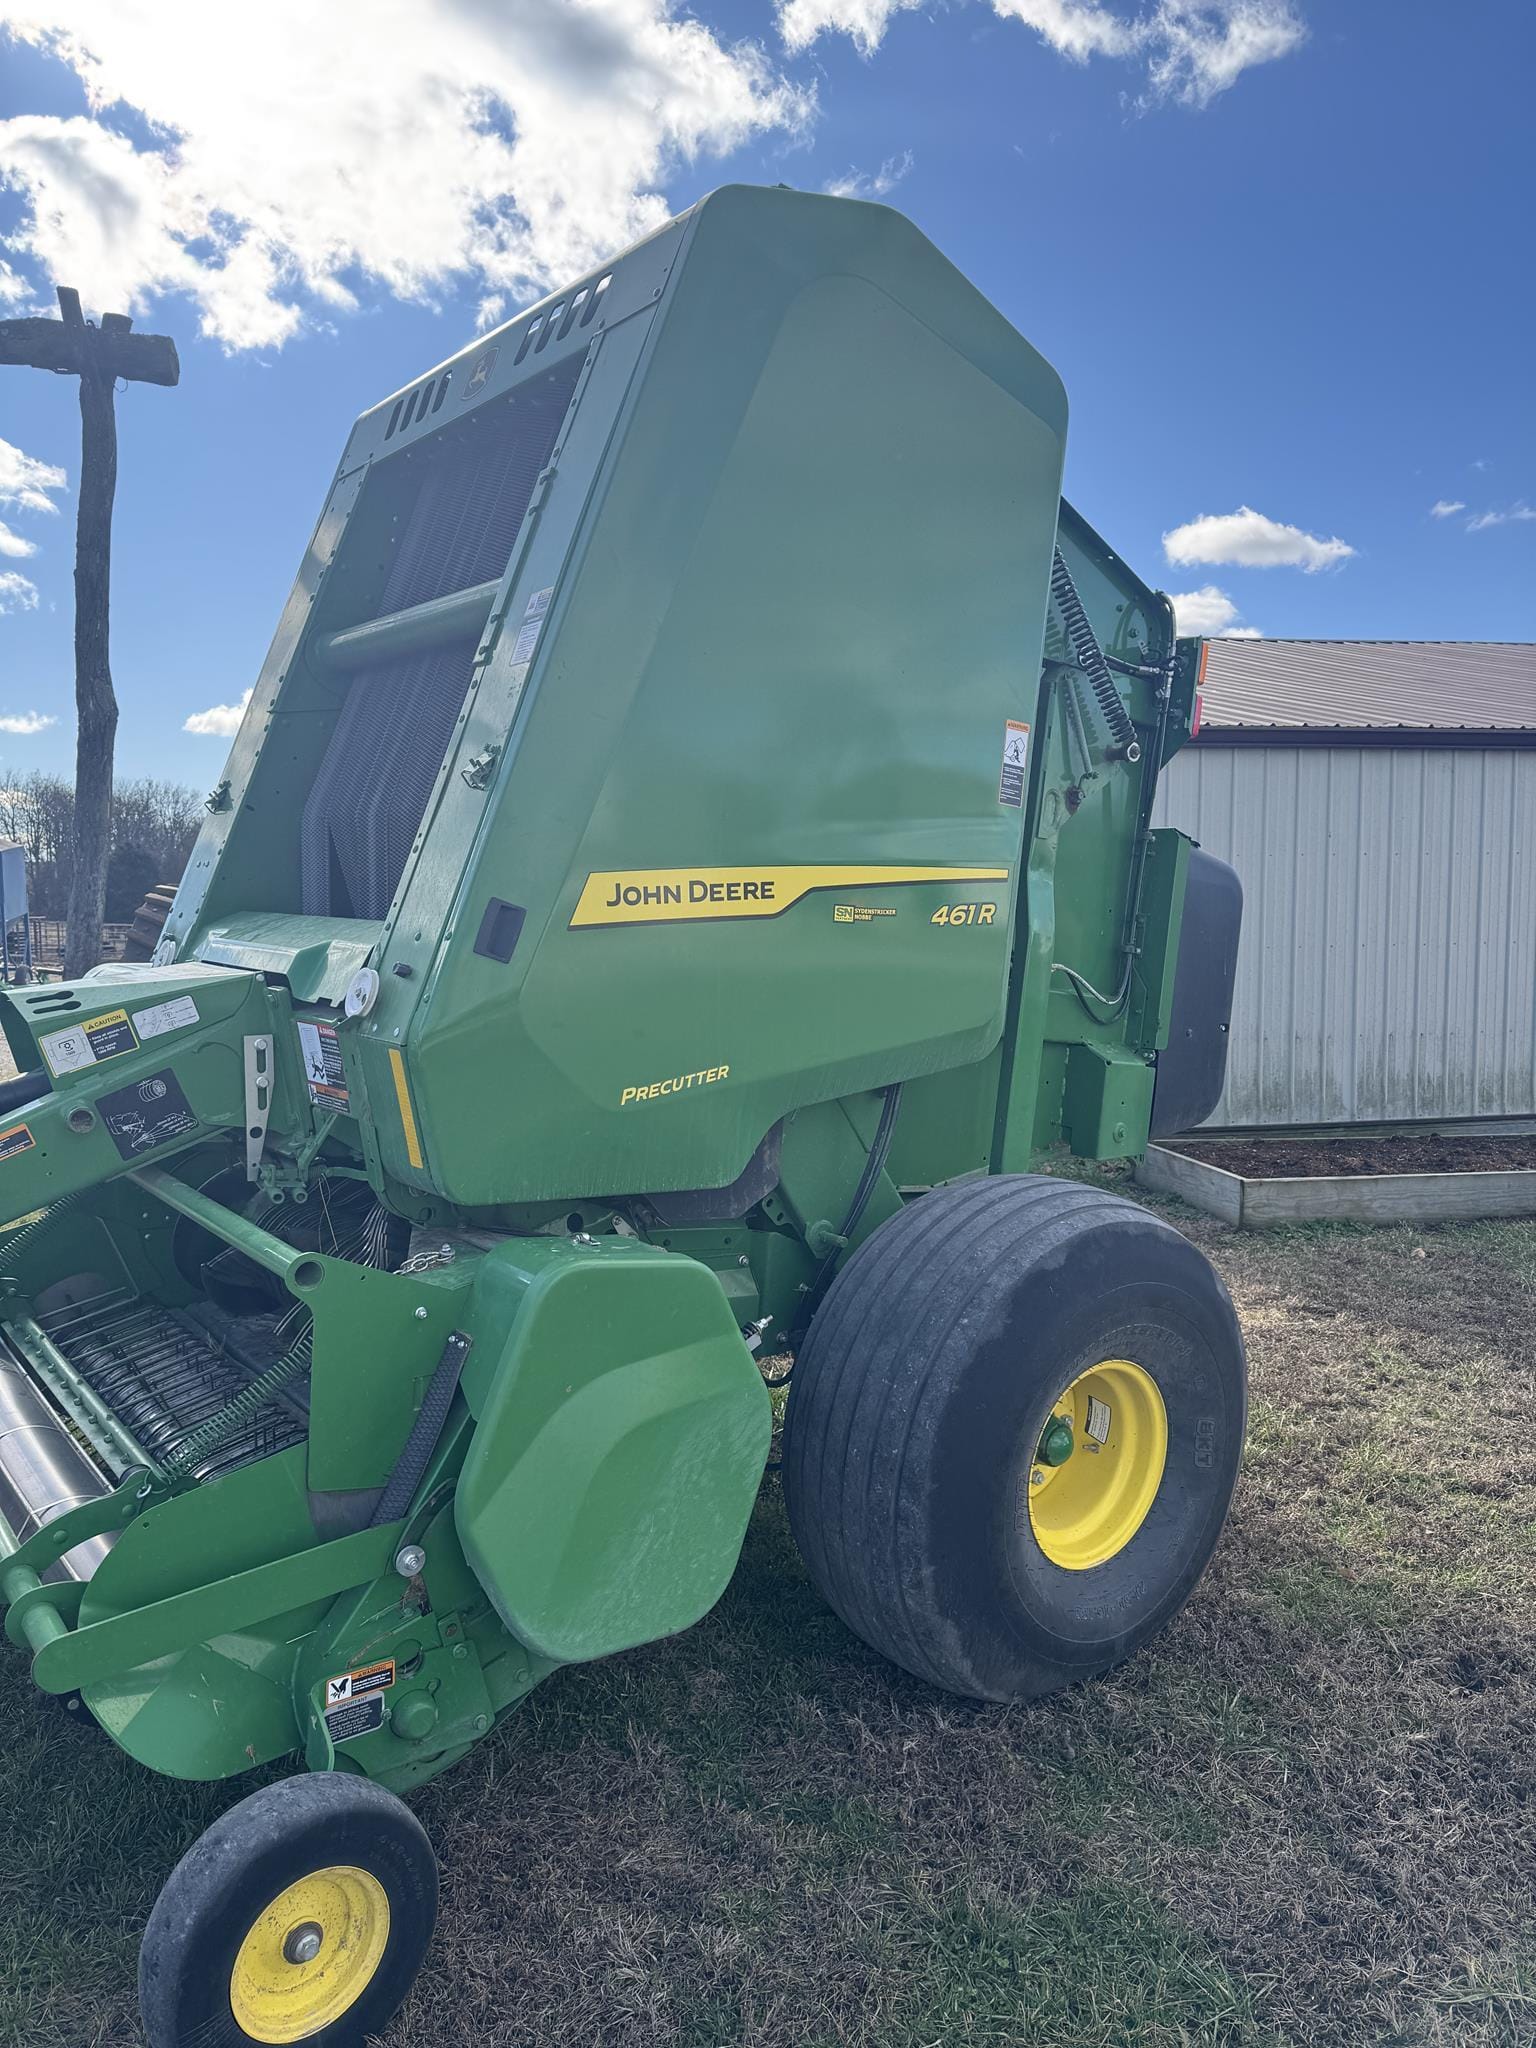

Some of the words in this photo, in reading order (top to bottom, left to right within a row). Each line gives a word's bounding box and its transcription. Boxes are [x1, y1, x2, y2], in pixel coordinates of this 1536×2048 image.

[606, 882, 682, 907] JOHN
[688, 880, 775, 903] DEERE
[836, 906, 853, 917] SN
[854, 907, 897, 916] SYDENSTRICKER
[930, 902, 996, 926] 461R
[94, 1014, 122, 1027] CAUTION
[620, 1065, 730, 1106] PRECUTTER
[338, 1696, 368, 1710] IMPORTANT
